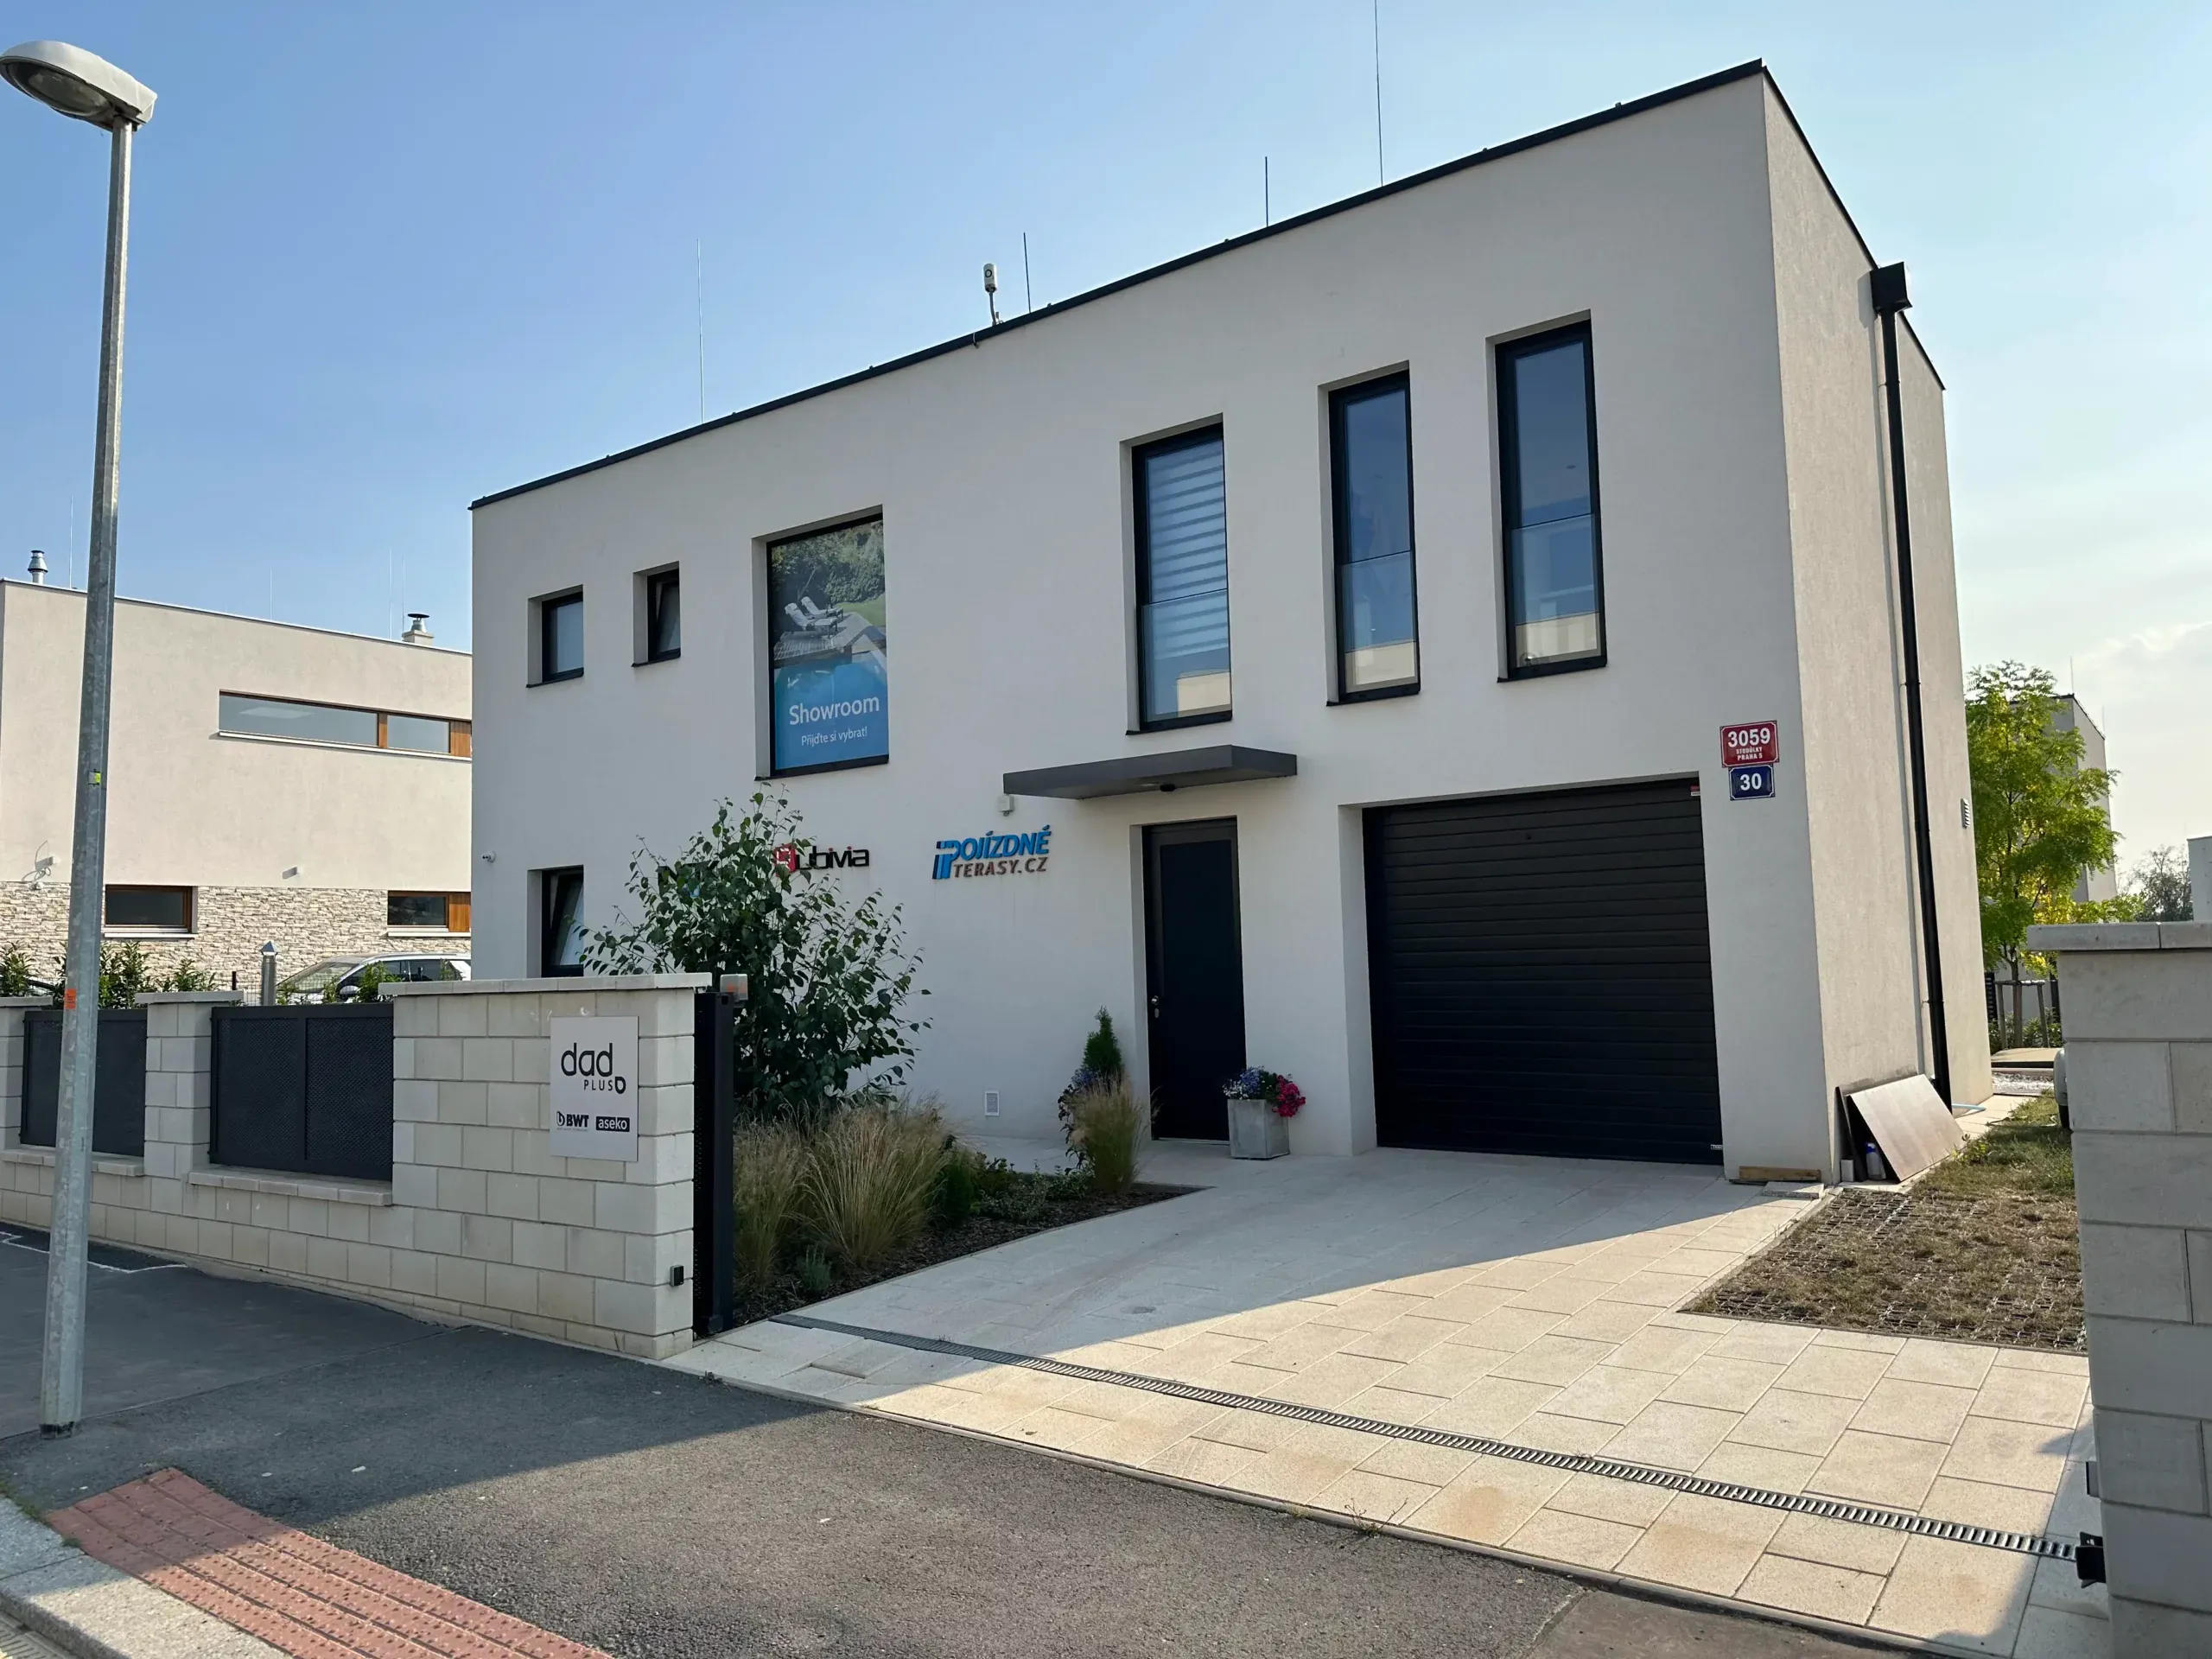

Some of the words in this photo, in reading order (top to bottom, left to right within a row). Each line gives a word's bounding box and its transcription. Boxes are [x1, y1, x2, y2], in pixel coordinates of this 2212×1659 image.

[789, 696, 880, 726] Showroom
[830, 730, 836, 742] si
[838, 726, 868, 743] vybrat!
[1728, 728, 1770, 747] 3059
[1737, 753, 1758, 761] PRAHA
[1740, 772, 1762, 791] 30
[932, 824, 1052, 880] POJÍZDNÉ
[954, 857, 1048, 878] TERASY.CZ
[561, 1042, 613, 1077] dad
[583, 1079, 613, 1091] PLUS
[566, 1114, 589, 1128] BWT
[598, 1117, 627, 1130] aseko
